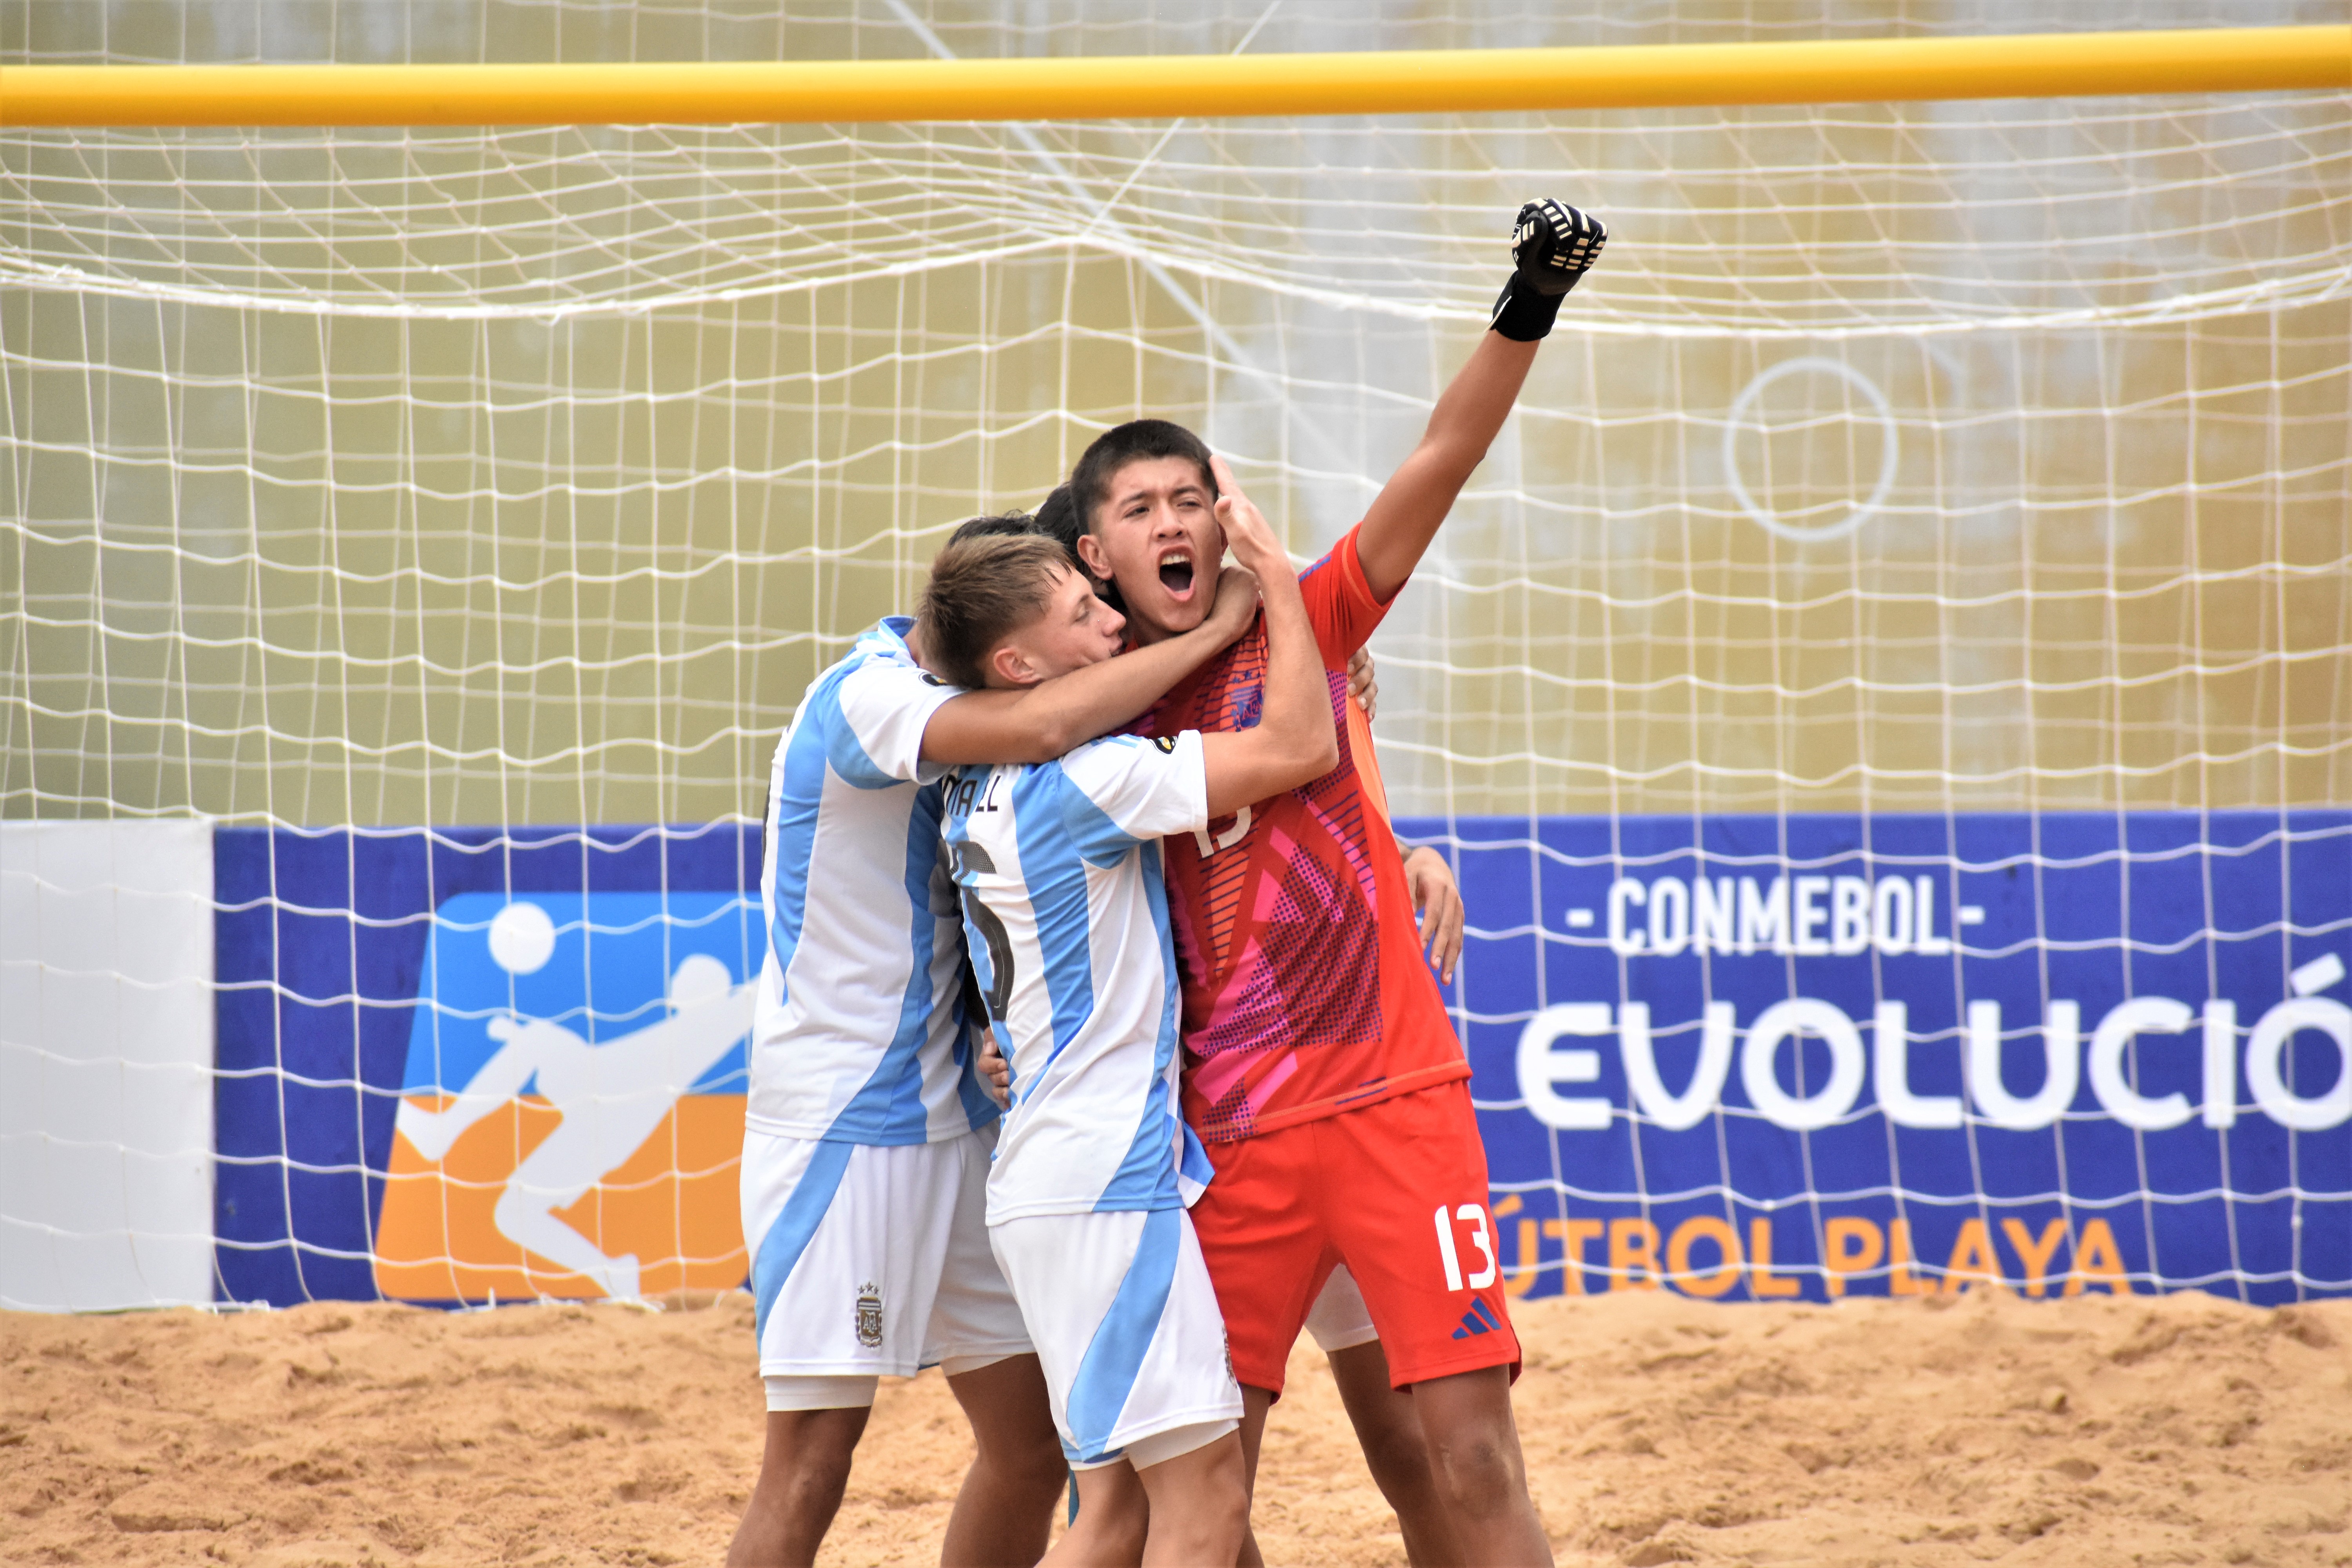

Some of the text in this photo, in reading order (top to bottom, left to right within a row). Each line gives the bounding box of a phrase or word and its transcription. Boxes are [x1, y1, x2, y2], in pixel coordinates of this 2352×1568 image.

[1515, 953, 2352, 1132] EVOLUCIÓ
[1434, 1203, 1496, 1291] 13
[1825, 1217, 2134, 1296] PLAYA
